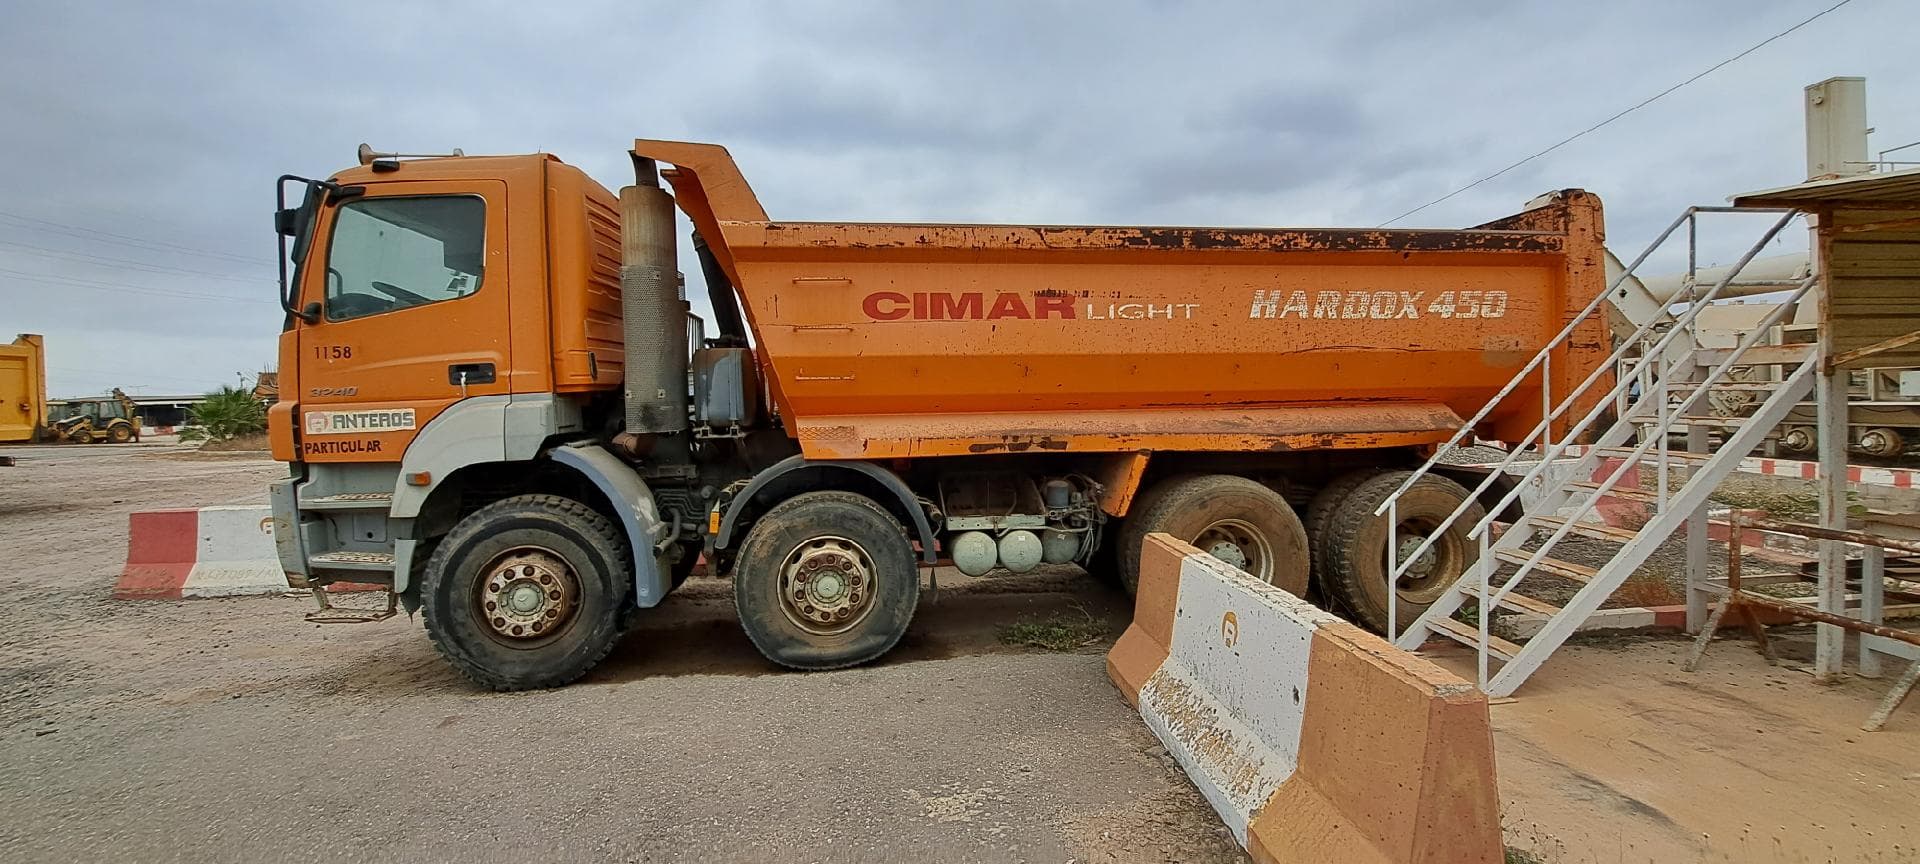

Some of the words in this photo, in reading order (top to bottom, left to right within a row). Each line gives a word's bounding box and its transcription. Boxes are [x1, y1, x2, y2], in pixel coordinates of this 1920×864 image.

[862, 291, 1076, 320] CIMAR
[1087, 303, 1200, 320] LIGHT
[1250, 290, 1424, 319] HARDOX
[1428, 290, 1508, 319] 450
[314, 346, 352, 359] 1158
[333, 412, 414, 429] ANTEROS
[304, 440, 381, 454] PARTICULAR
